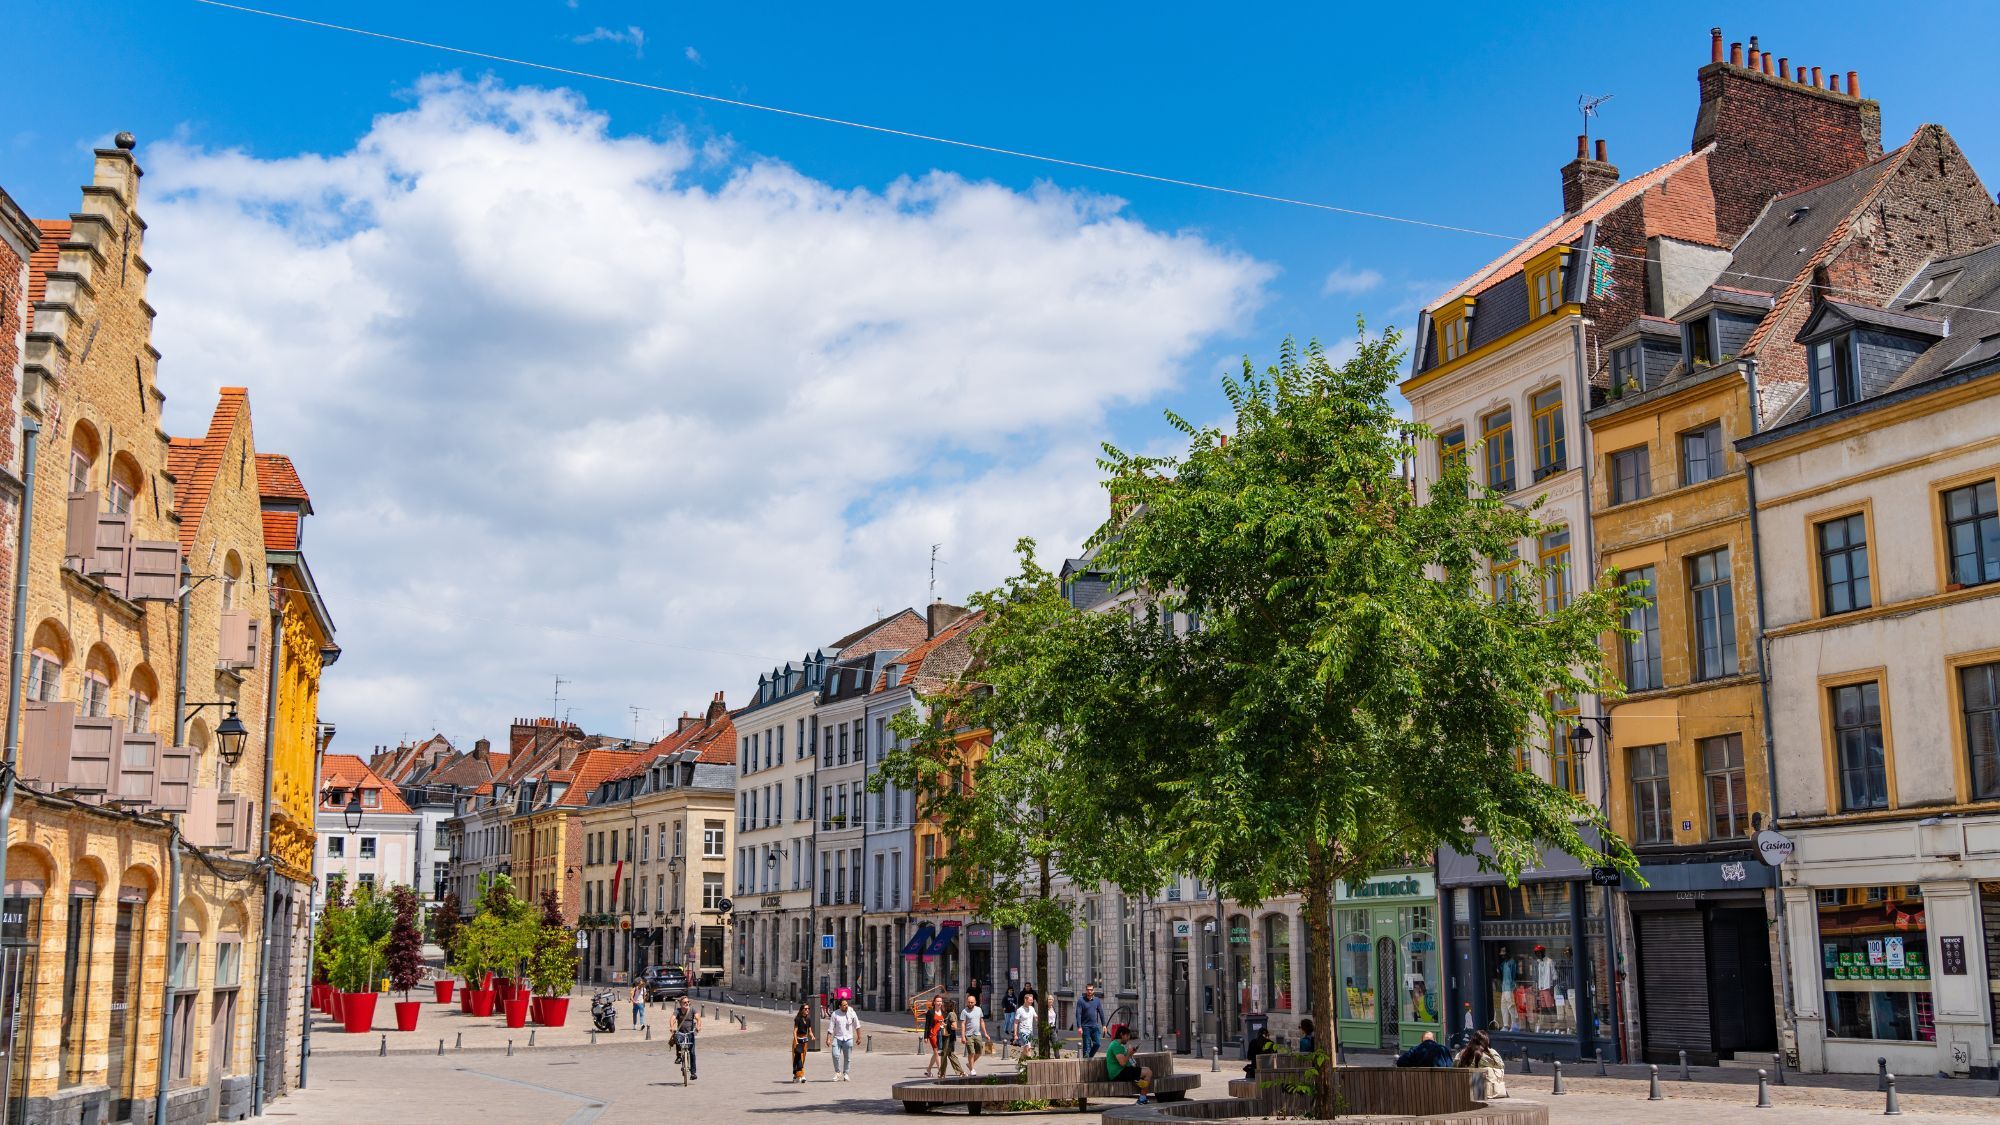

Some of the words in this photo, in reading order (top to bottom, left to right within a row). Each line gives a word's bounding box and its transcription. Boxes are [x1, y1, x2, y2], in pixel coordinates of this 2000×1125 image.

[1760, 841, 1790, 852] Casino
[1593, 869, 1618, 884] Cozette
[3, 912, 23, 924] ZANE
[1869, 941, 1880, 952] 100
